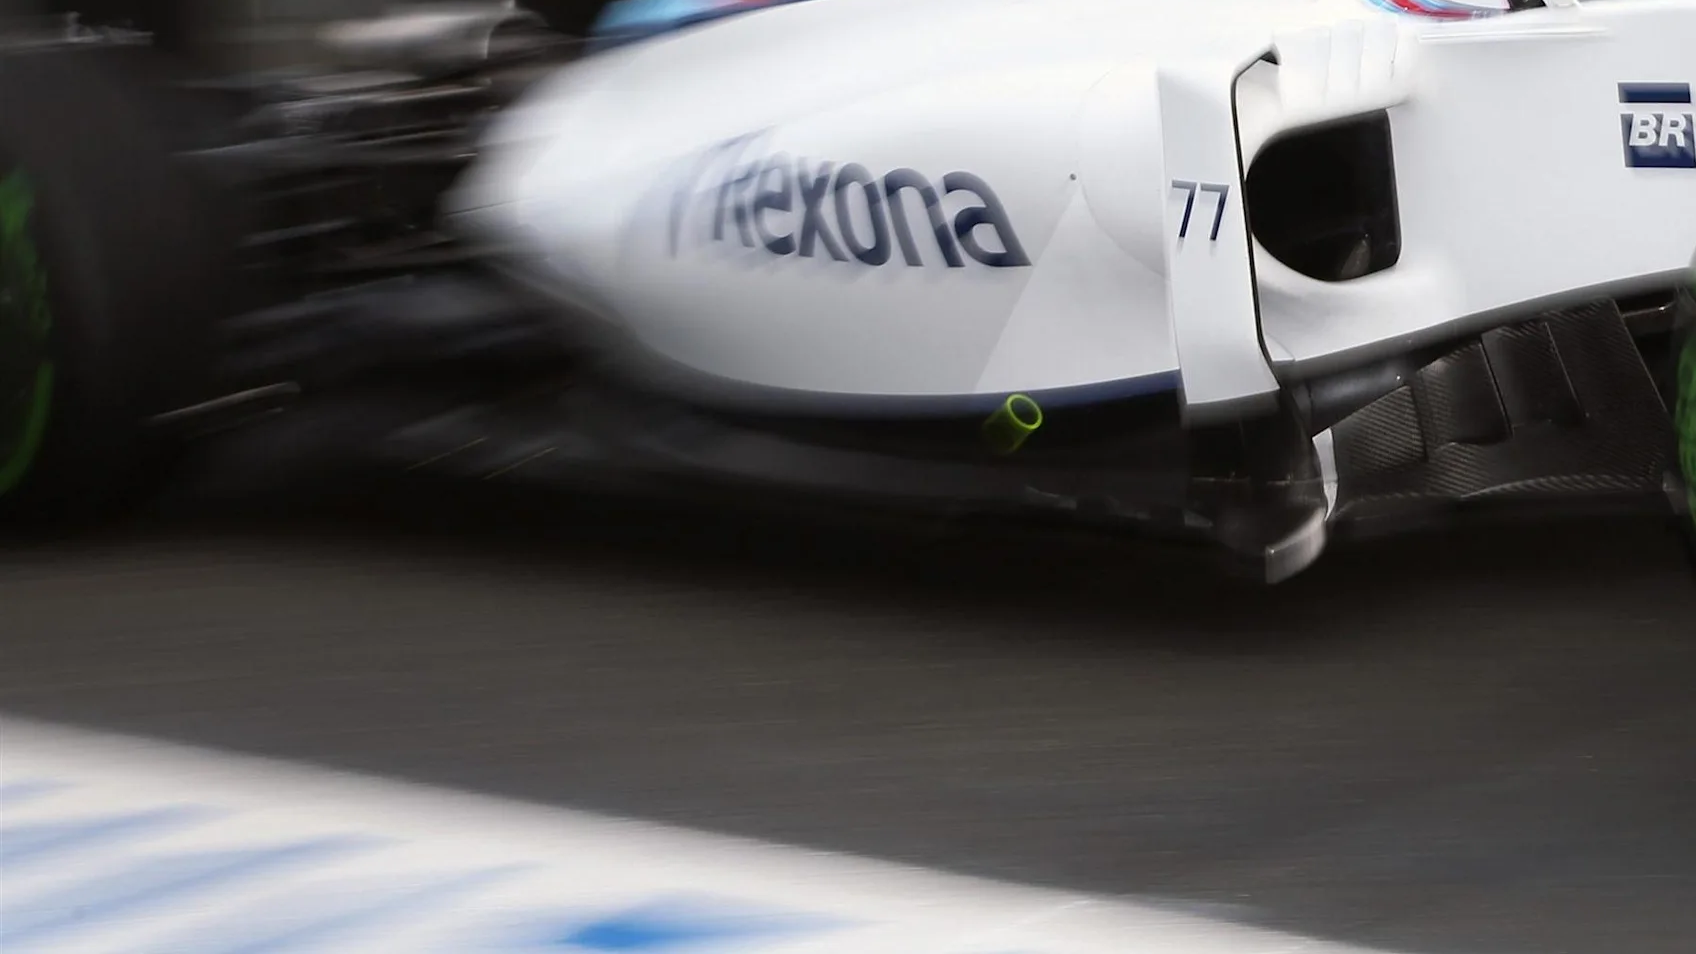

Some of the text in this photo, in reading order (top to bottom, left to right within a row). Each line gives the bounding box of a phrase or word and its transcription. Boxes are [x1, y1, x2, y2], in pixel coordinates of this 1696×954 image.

[1628, 111, 1688, 147] BR
[705, 150, 1033, 269] Rexona
[1170, 178, 1230, 243] 77
